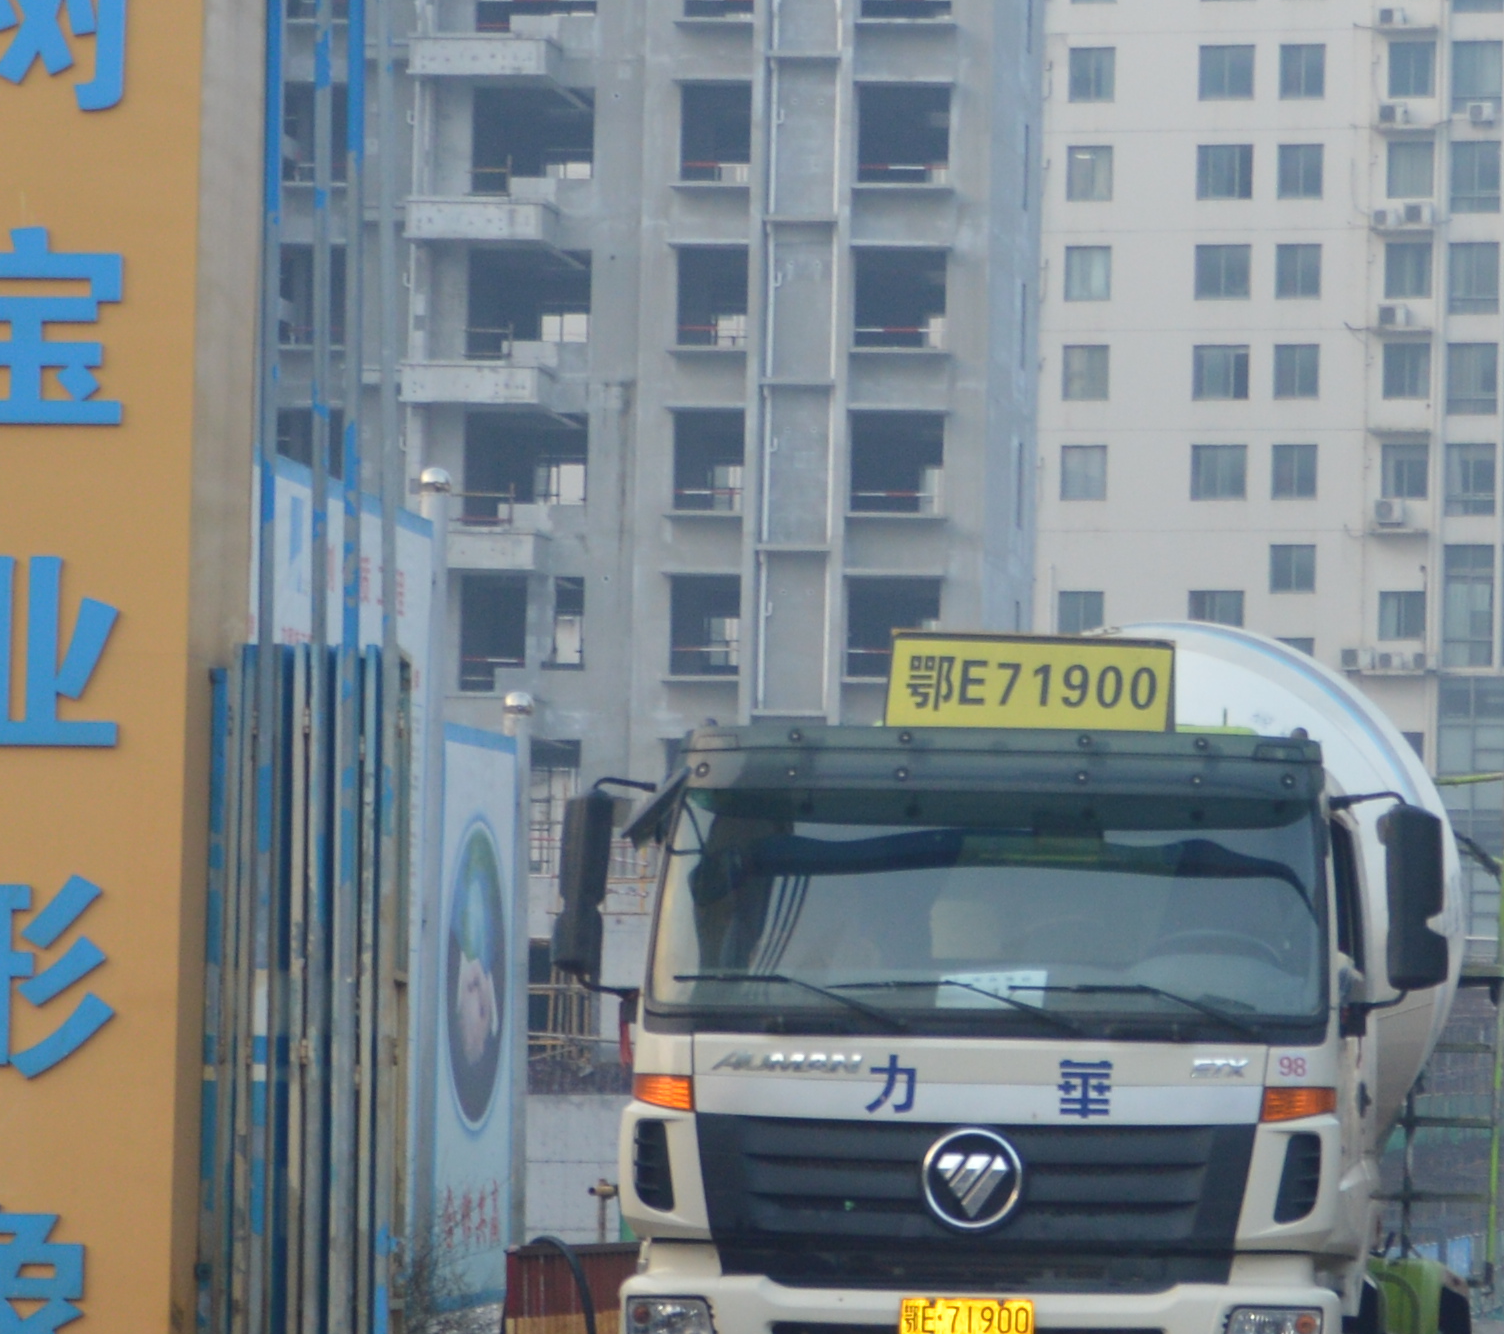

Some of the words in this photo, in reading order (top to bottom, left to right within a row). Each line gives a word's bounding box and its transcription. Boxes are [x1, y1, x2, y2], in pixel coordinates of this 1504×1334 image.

[906, 654, 1157, 712] 鄂E71900
[712, 1051, 863, 1074] AUMAN
[1279, 1056, 1308, 1077] 98
